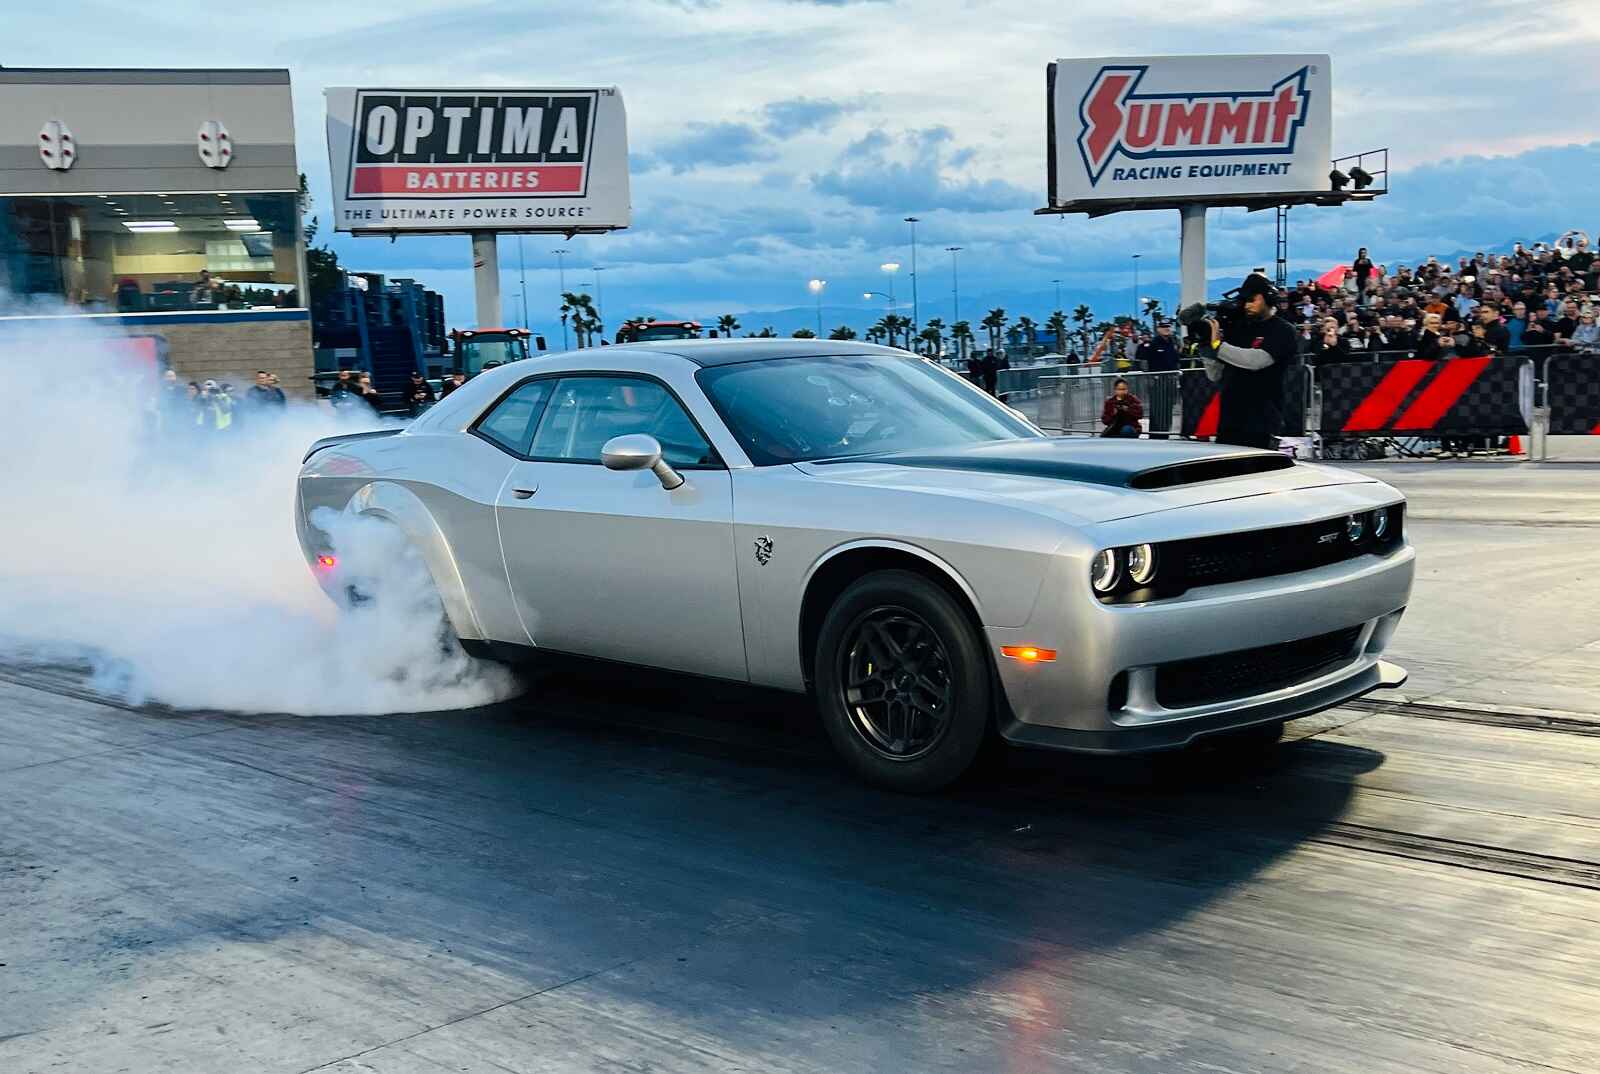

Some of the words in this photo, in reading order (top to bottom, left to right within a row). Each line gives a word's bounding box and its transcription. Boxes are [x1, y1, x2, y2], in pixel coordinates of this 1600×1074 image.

[367, 105, 579, 155] OPTIMA
[407, 171, 539, 189] BATTERIES
[1112, 166, 1182, 181] RACING
[1187, 162, 1292, 179] EQUIPMENT
[345, 209, 372, 220] THE
[380, 209, 455, 219] ULTIMATE
[463, 208, 517, 218] POWER
